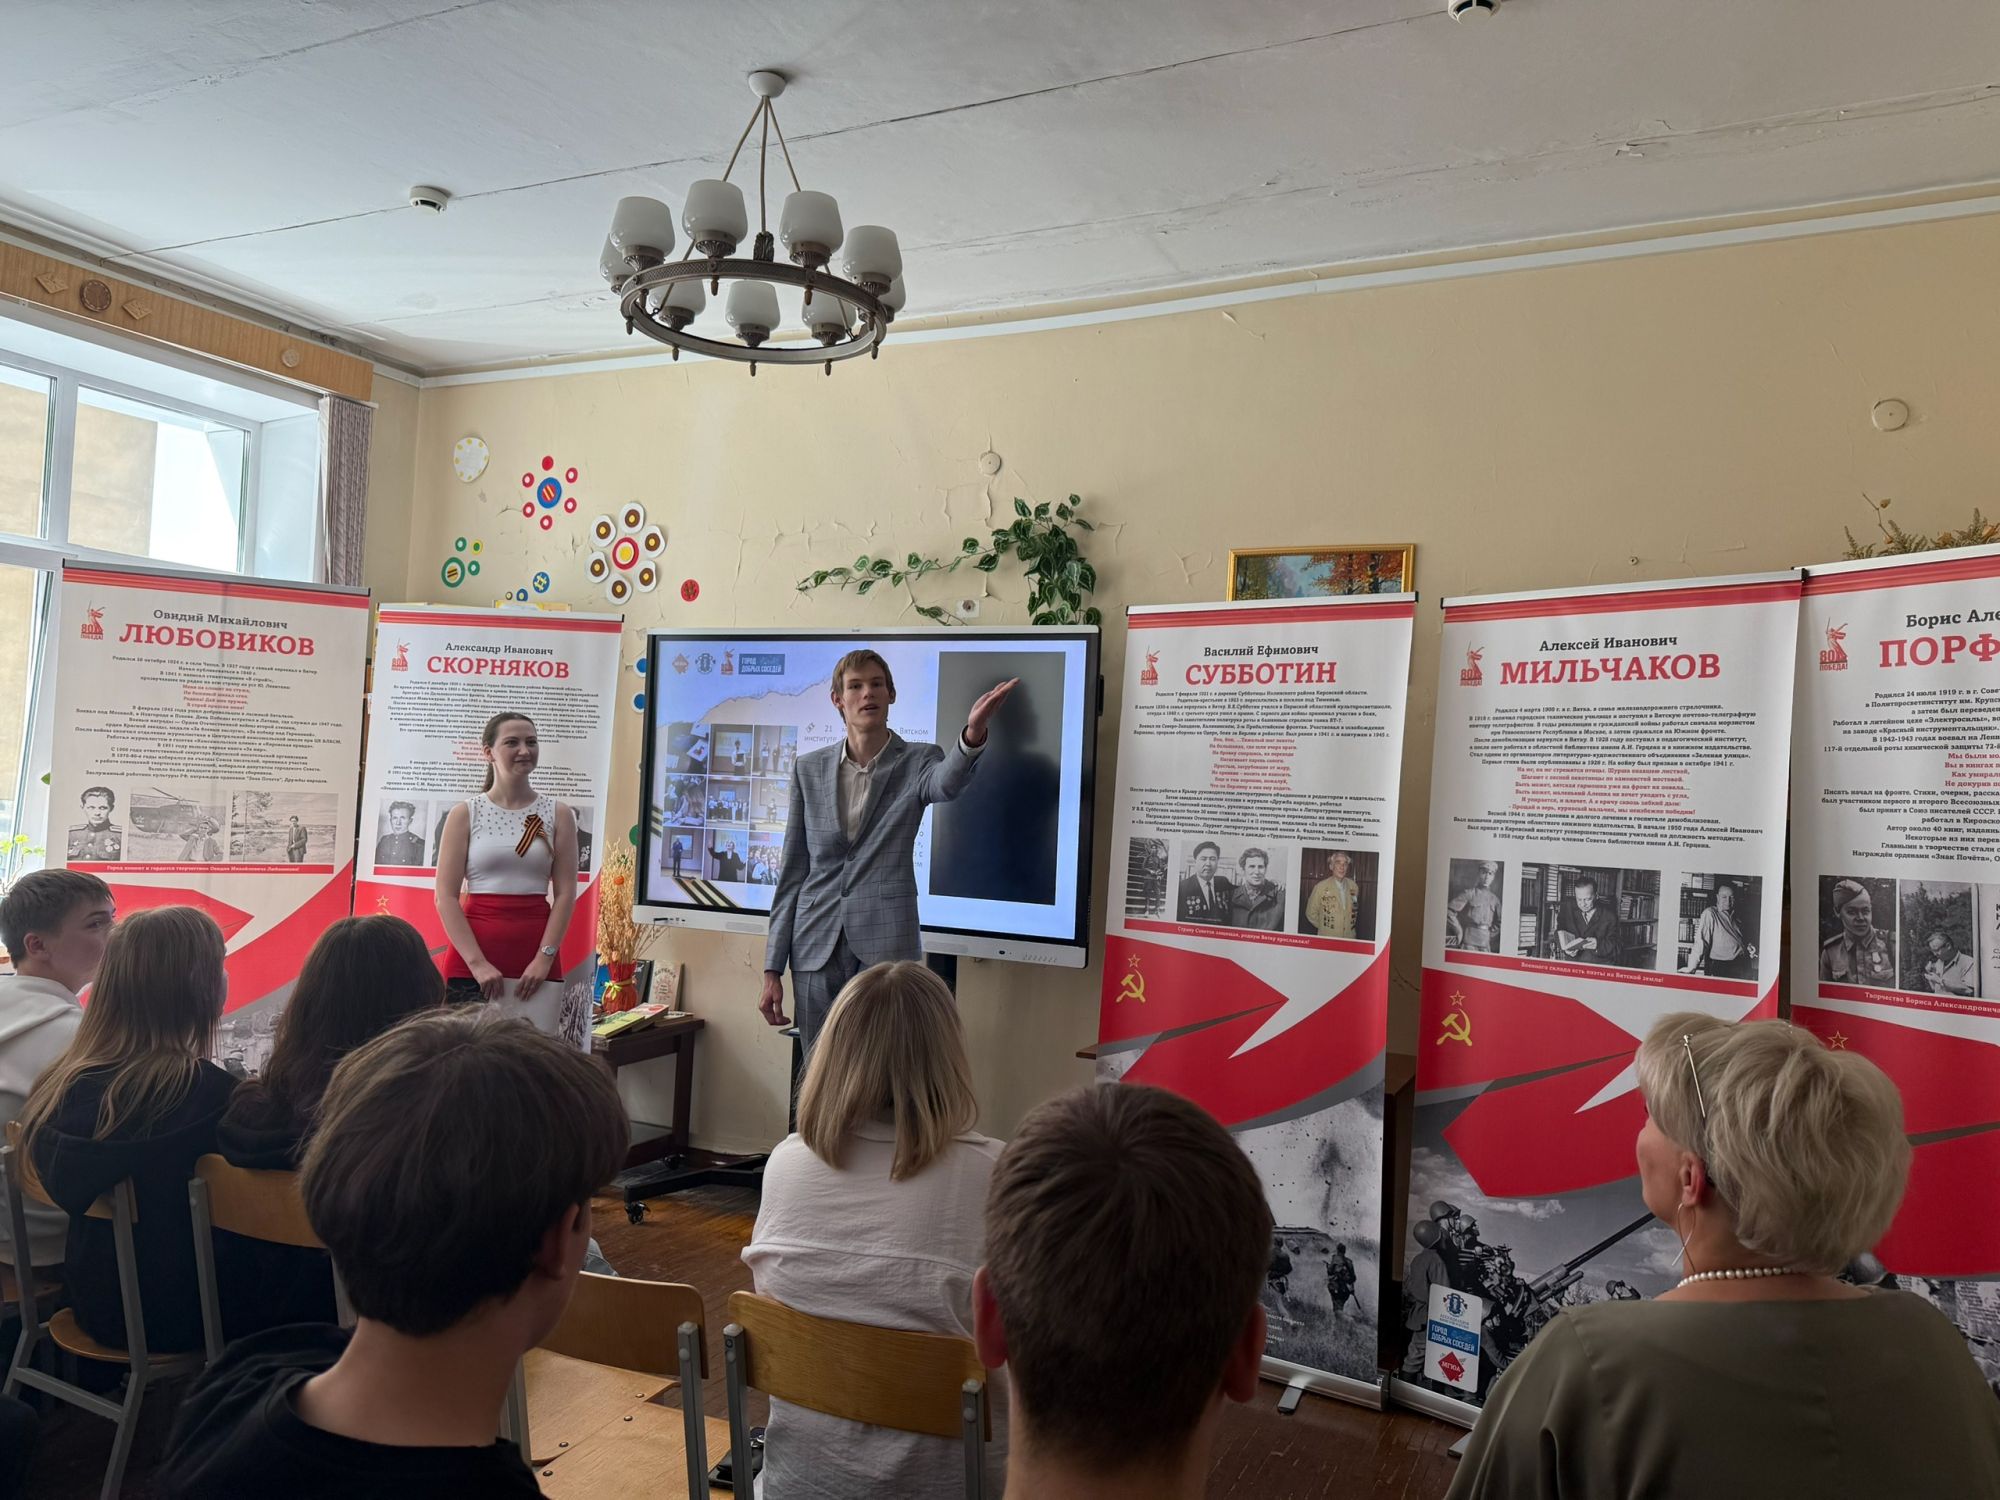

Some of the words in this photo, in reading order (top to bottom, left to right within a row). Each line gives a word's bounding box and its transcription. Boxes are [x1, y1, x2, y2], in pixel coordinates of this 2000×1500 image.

[154, 609, 203, 623] Овидий
[208, 614, 288, 629] Михайлович
[1906, 614, 1961, 629] Борис
[119, 624, 315, 656] ЛЮБОВИКОВ
[1540, 638, 1599, 652] Алексей
[1603, 636, 1678, 648] Иванович
[445, 642, 501, 655] Александр
[504, 645, 553, 656] Иванович
[1204, 646, 1254, 657] Василий
[1257, 645, 1319, 657] Ефимович
[1879, 634, 2000, 667] ПОРФ
[427, 656, 569, 678] СКОРНЯКОВ
[1185, 662, 1336, 685] СУББОТИН
[1500, 653, 1721, 685] МИЛЬЧАКОВ
[1819, 663, 1848, 672] ПОБЕДА!
[1865, 990, 1904, 1002] Творчество
[1905, 996, 1931, 1006] Бориса
[1432, 1324, 1448, 1336] ГОРОД
[1432, 1333, 1452, 1345] ДОБРЫХ
[1452, 1339, 1474, 1352] СОСЕДЕЙ
